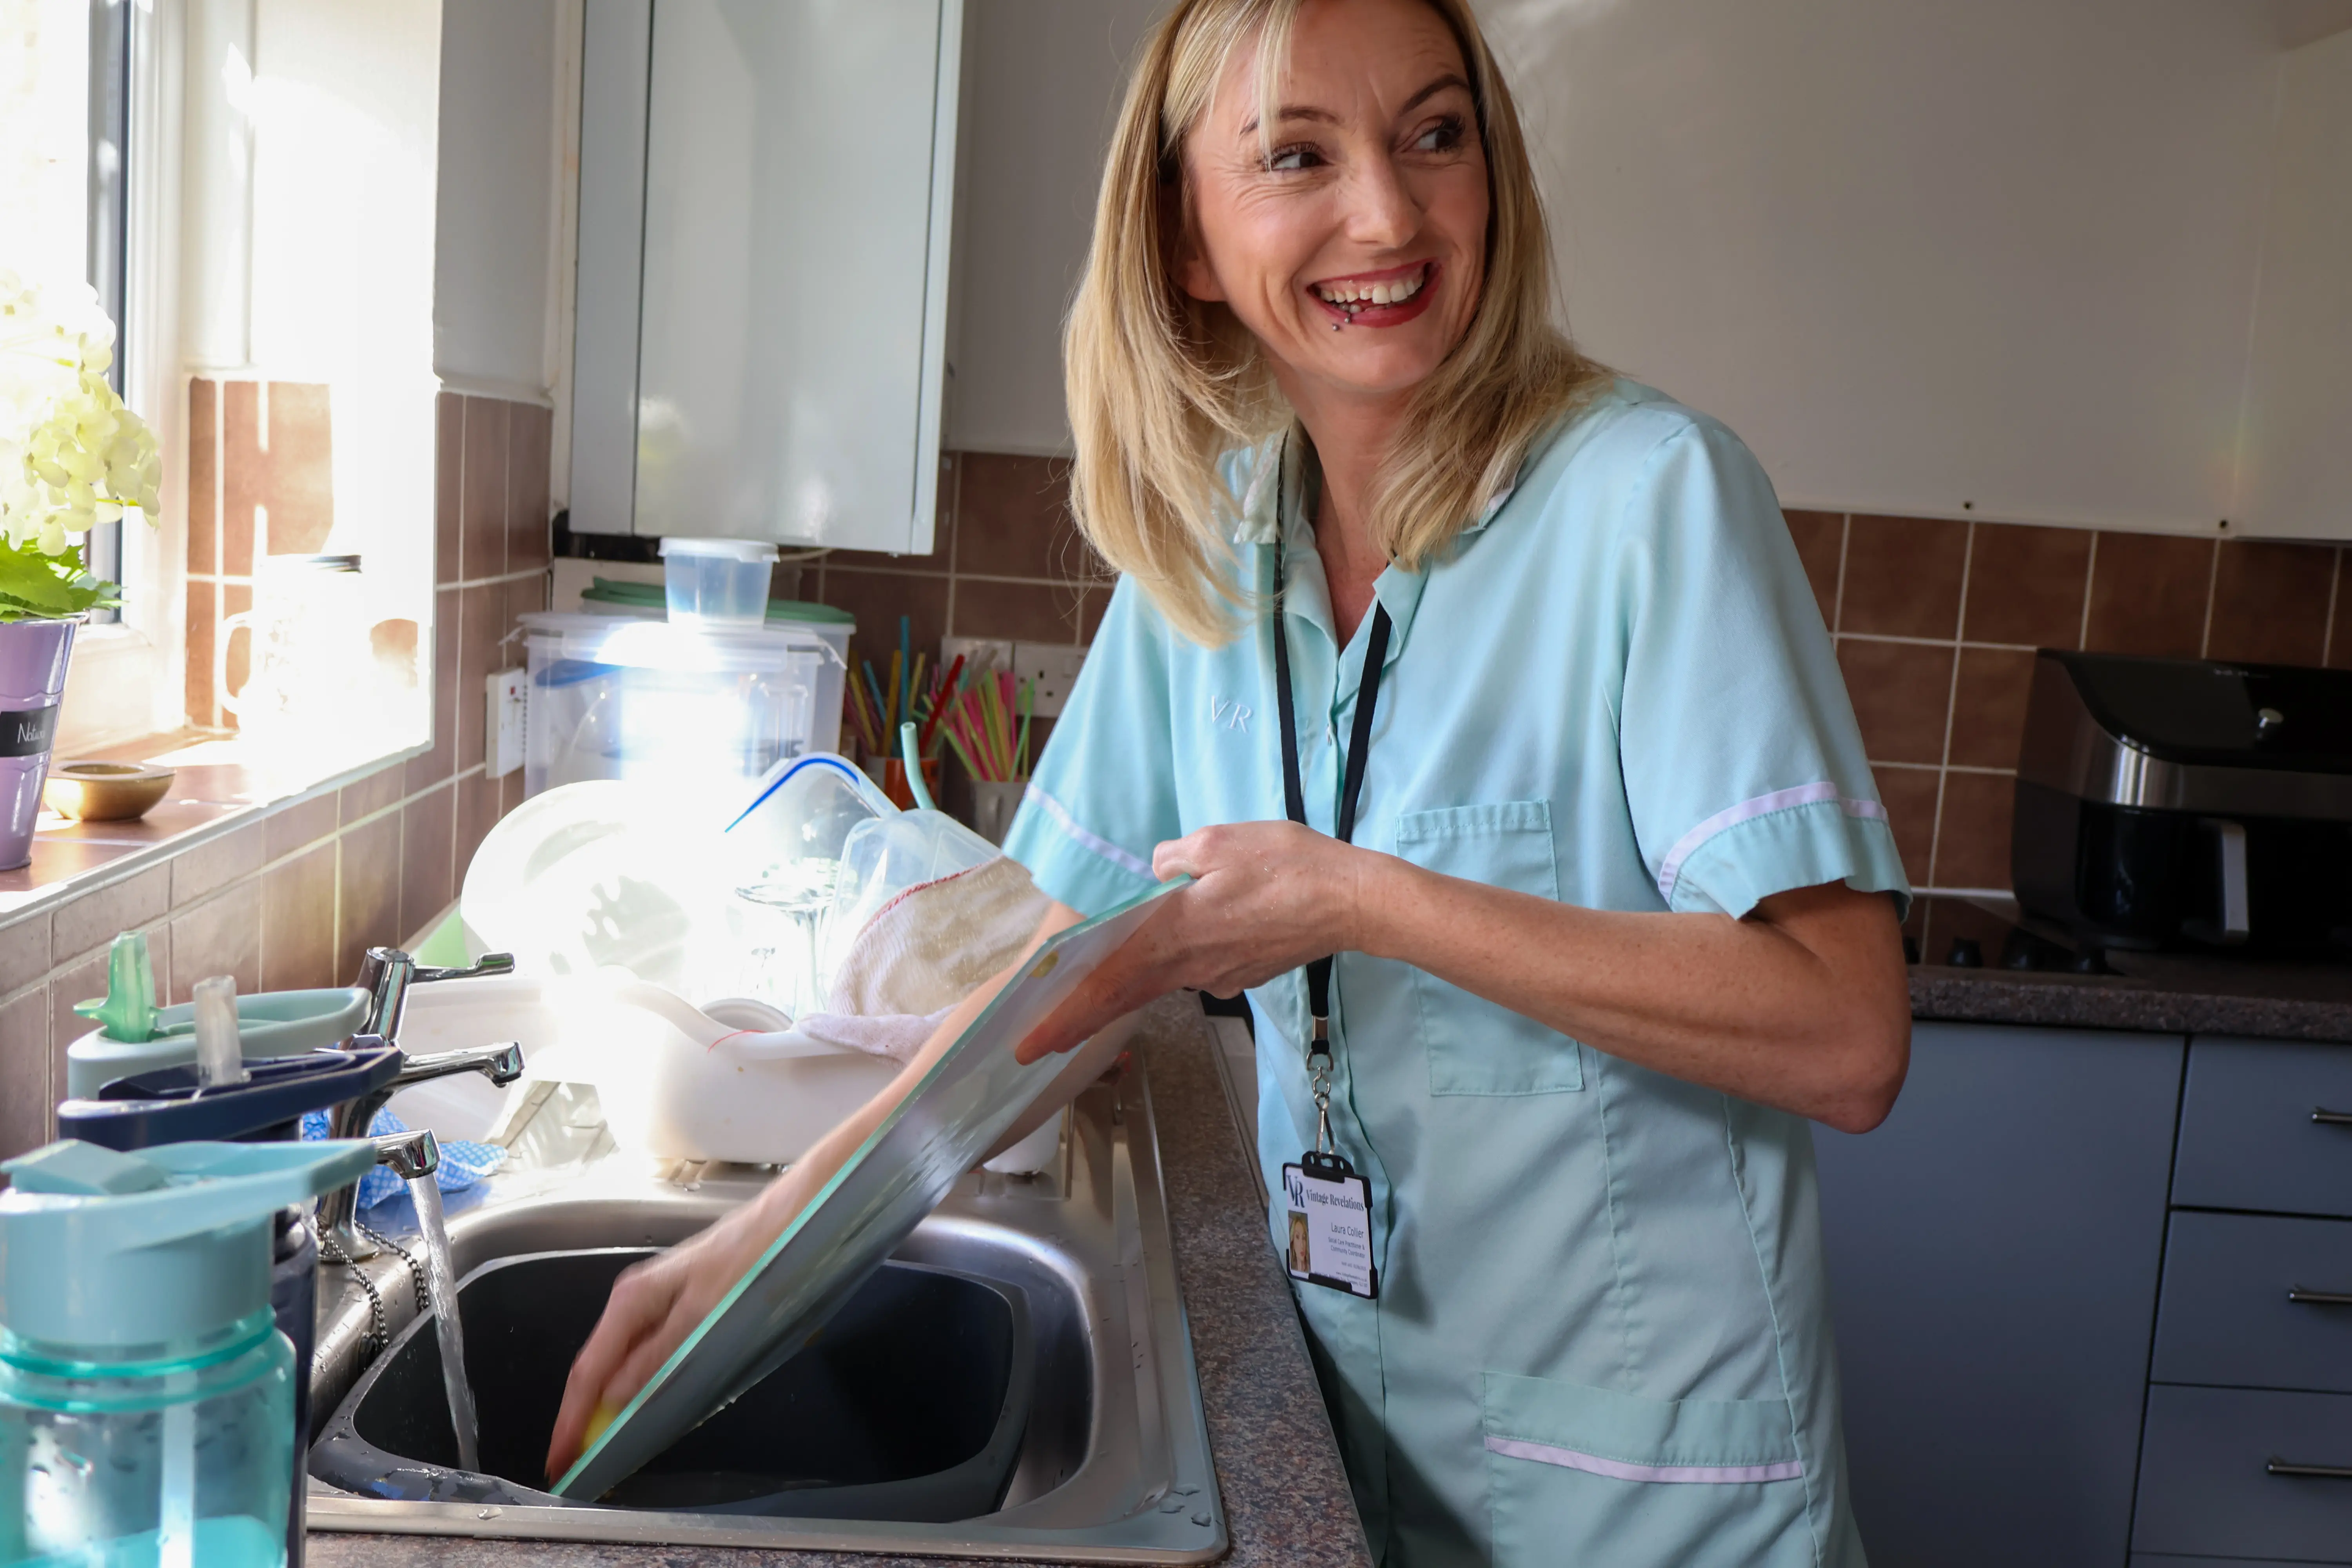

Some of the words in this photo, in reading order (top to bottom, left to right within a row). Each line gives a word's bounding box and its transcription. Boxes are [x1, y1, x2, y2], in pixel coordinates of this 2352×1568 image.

[1211, 695, 1251, 734] VR
[1287, 1175, 1305, 1208] VR
[1306, 1189, 1328, 1205] Vintage
[1330, 1194, 1364, 1211] Revelations
[1331, 1222, 1345, 1234] Laura
[1347, 1226, 1363, 1238] Collier
